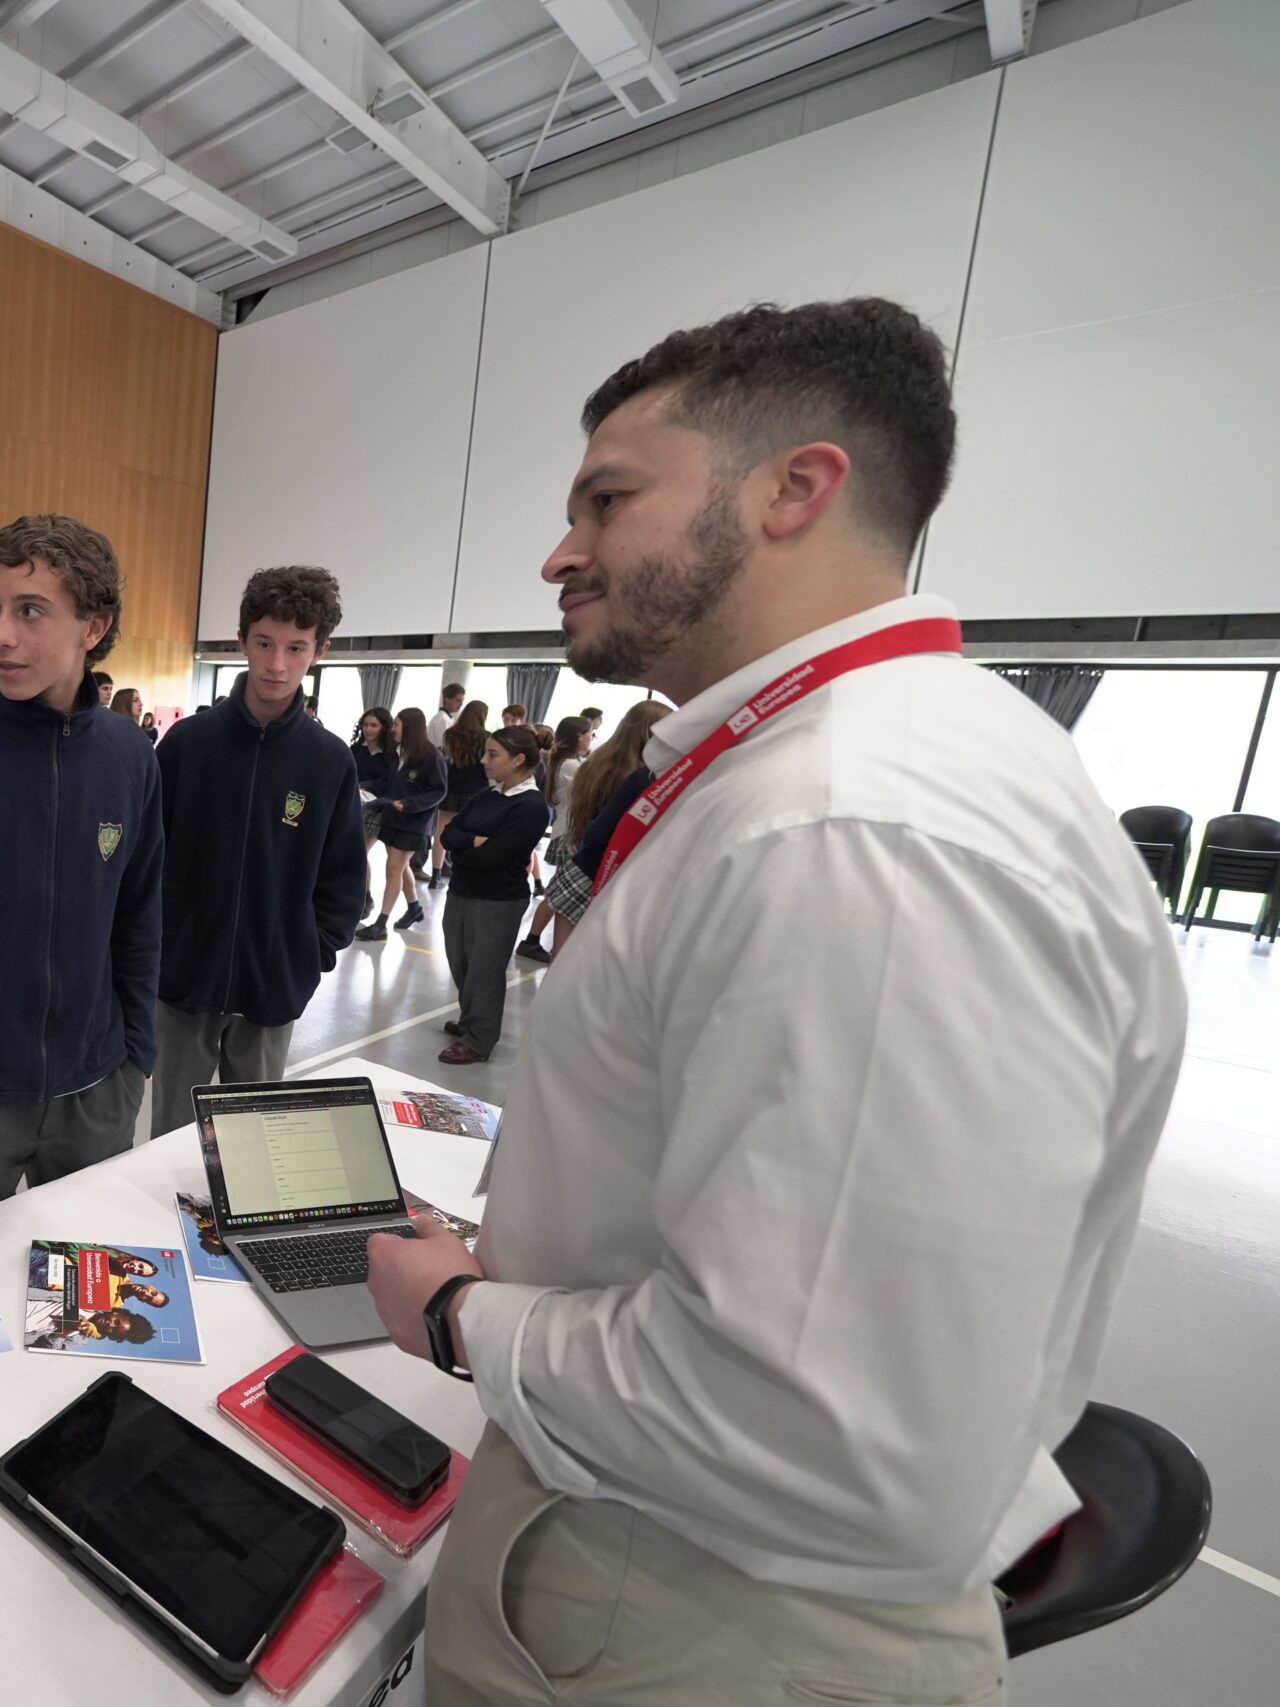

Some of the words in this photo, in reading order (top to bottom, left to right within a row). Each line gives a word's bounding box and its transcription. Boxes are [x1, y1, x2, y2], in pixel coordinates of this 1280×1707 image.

[752, 664, 815, 710] Universidad
[648, 758, 693, 800] Universidad
[86, 1252, 94, 1280] Universidad
[87, 1280, 95, 1304] Europea
